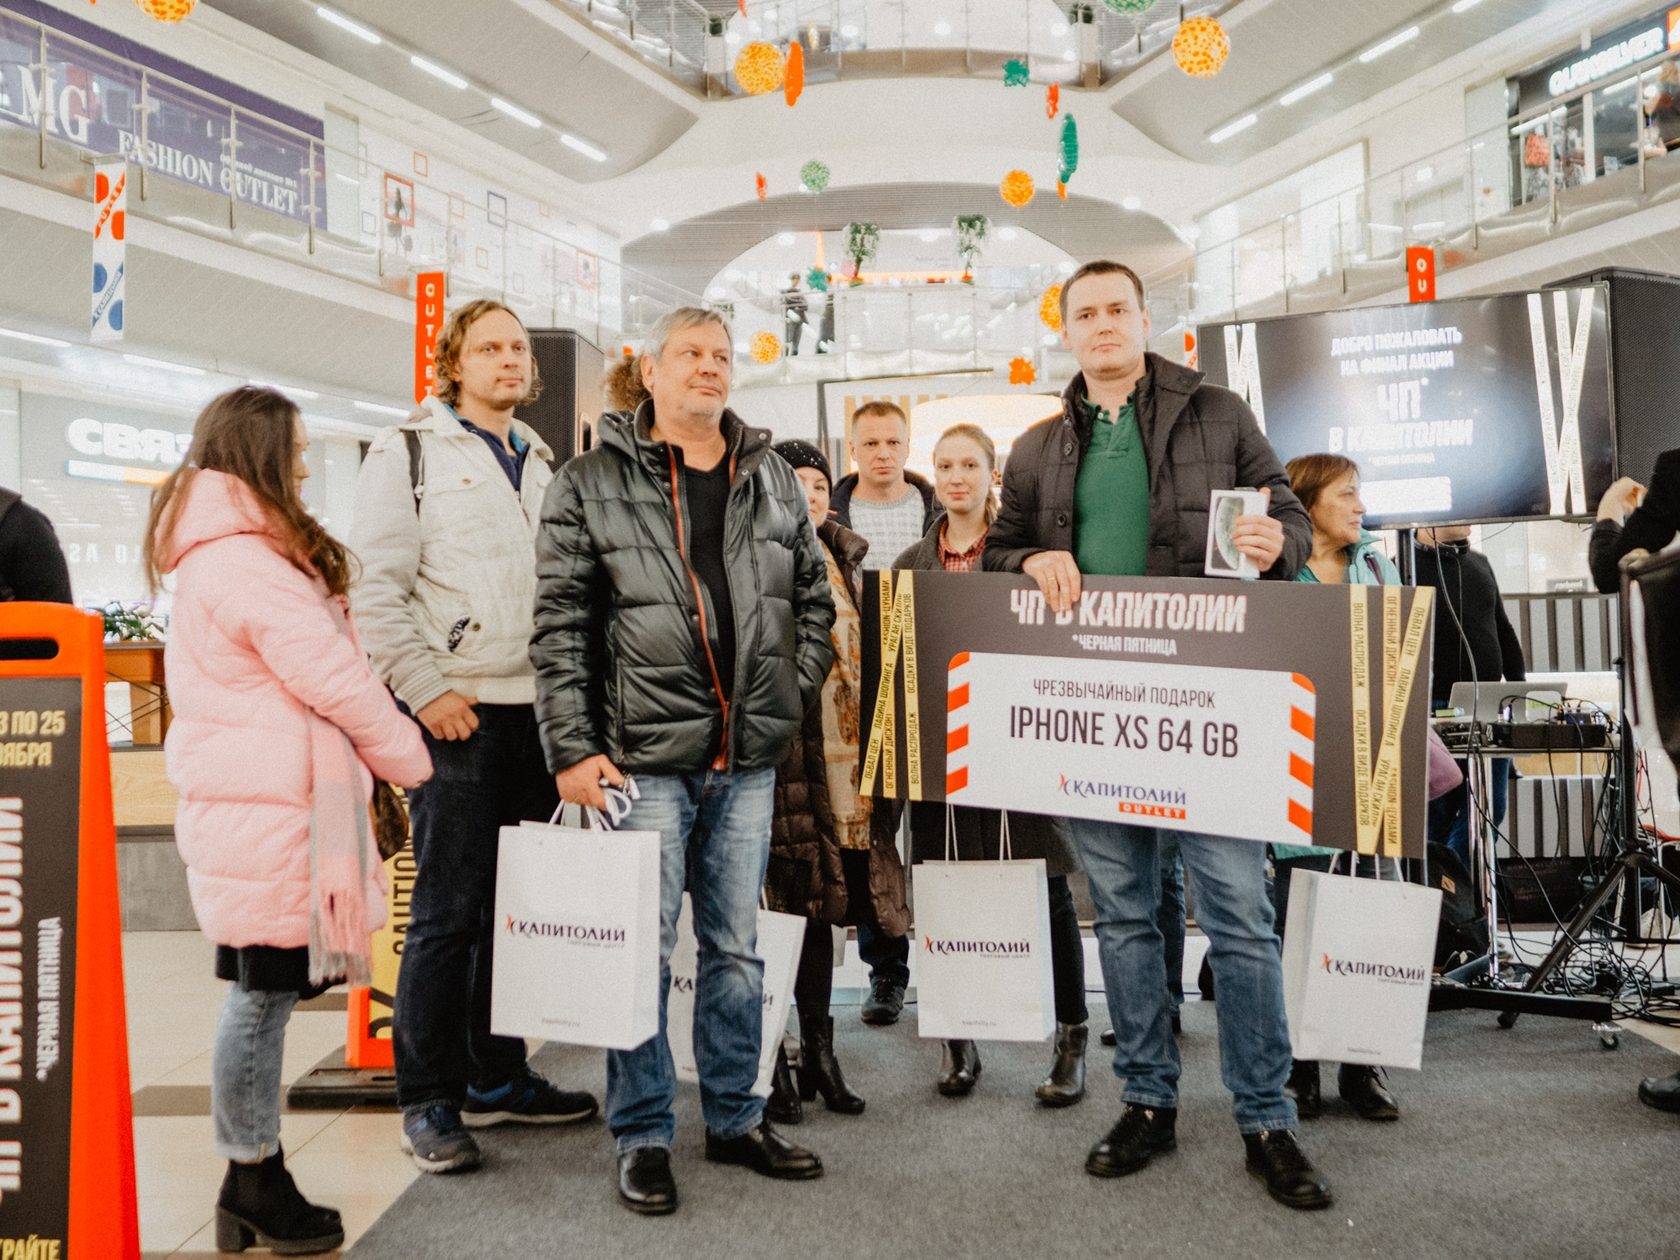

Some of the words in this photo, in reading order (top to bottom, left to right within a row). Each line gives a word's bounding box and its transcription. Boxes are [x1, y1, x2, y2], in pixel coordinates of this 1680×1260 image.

[118, 129, 214, 187] FASHION
[220, 167, 298, 216] OUTLET
[425, 282, 436, 396] OUTLET
[1374, 327, 1463, 351] ПОЖАЛОВАТЬ
[1340, 359, 1359, 376] НА
[1408, 350, 1455, 370] АКЦИИ
[1329, 426, 1344, 453] В
[903, 593, 914, 632] ПОДАРКОВ
[1010, 588, 1046, 625] ЧП
[1079, 590, 1248, 633] КАПИТОЛИИ
[1353, 602, 1364, 632] ВОЛНА
[1386, 595, 1397, 645] ОГНЕННЫЙ
[1409, 606, 1425, 637] ОБВАЛ
[888, 622, 900, 652] УРАГАН
[905, 633, 914, 655] ВИДЕ
[1123, 636, 1178, 656] ПЯТНИЦА
[1405, 637, 1418, 656] ЦЕН
[1354, 634, 1366, 688] РАСПРОДАЖ
[880, 662, 894, 699] ШОПИНГА
[906, 663, 916, 694] ОСАДКИ
[1034, 678, 1146, 703] ЧРЕЗВЫЧАЙНЫЙ
[1150, 687, 1216, 708] ПОДАРОК
[1394, 667, 1411, 703] ЛАВИНА
[11, 710, 38, 736] ПО
[39, 710, 66, 736] 25
[873, 700, 887, 729] ЛАВИНА
[1356, 709, 1368, 744] ОСАДКИ
[1385, 703, 1403, 747] ШОПИНГА
[869, 738, 880, 754] ЦЕН
[909, 712, 919, 759] РАСПРОДАЖ
[1010, 705, 1105, 746] IPHONE
[1114, 713, 1149, 750] XS
[1158, 717, 1193, 754] 64
[1203, 721, 1239, 758] GB
[864, 754, 876, 780] ОБВАЛ
[885, 750, 894, 789] ОГНЕННЫЙ
[910, 759, 920, 785] ВОЛНА
[1357, 754, 1369, 777] ВИДЕ
[1376, 759, 1391, 794] УРАГАН
[1073, 779, 1186, 805] КАПИТОЛИЙ
[1359, 779, 1370, 826] ПОДАРКОВ
[1123, 803, 1183, 818] OUTLET
[37, 916, 63, 1000] ПЯТНИЦА
[937, 938, 1031, 956] КАПИТОЛИЙ
[1335, 959, 1425, 981] КАПИТОЛИЙ
[0, 1233, 61, 1260] РАЙТЕ
